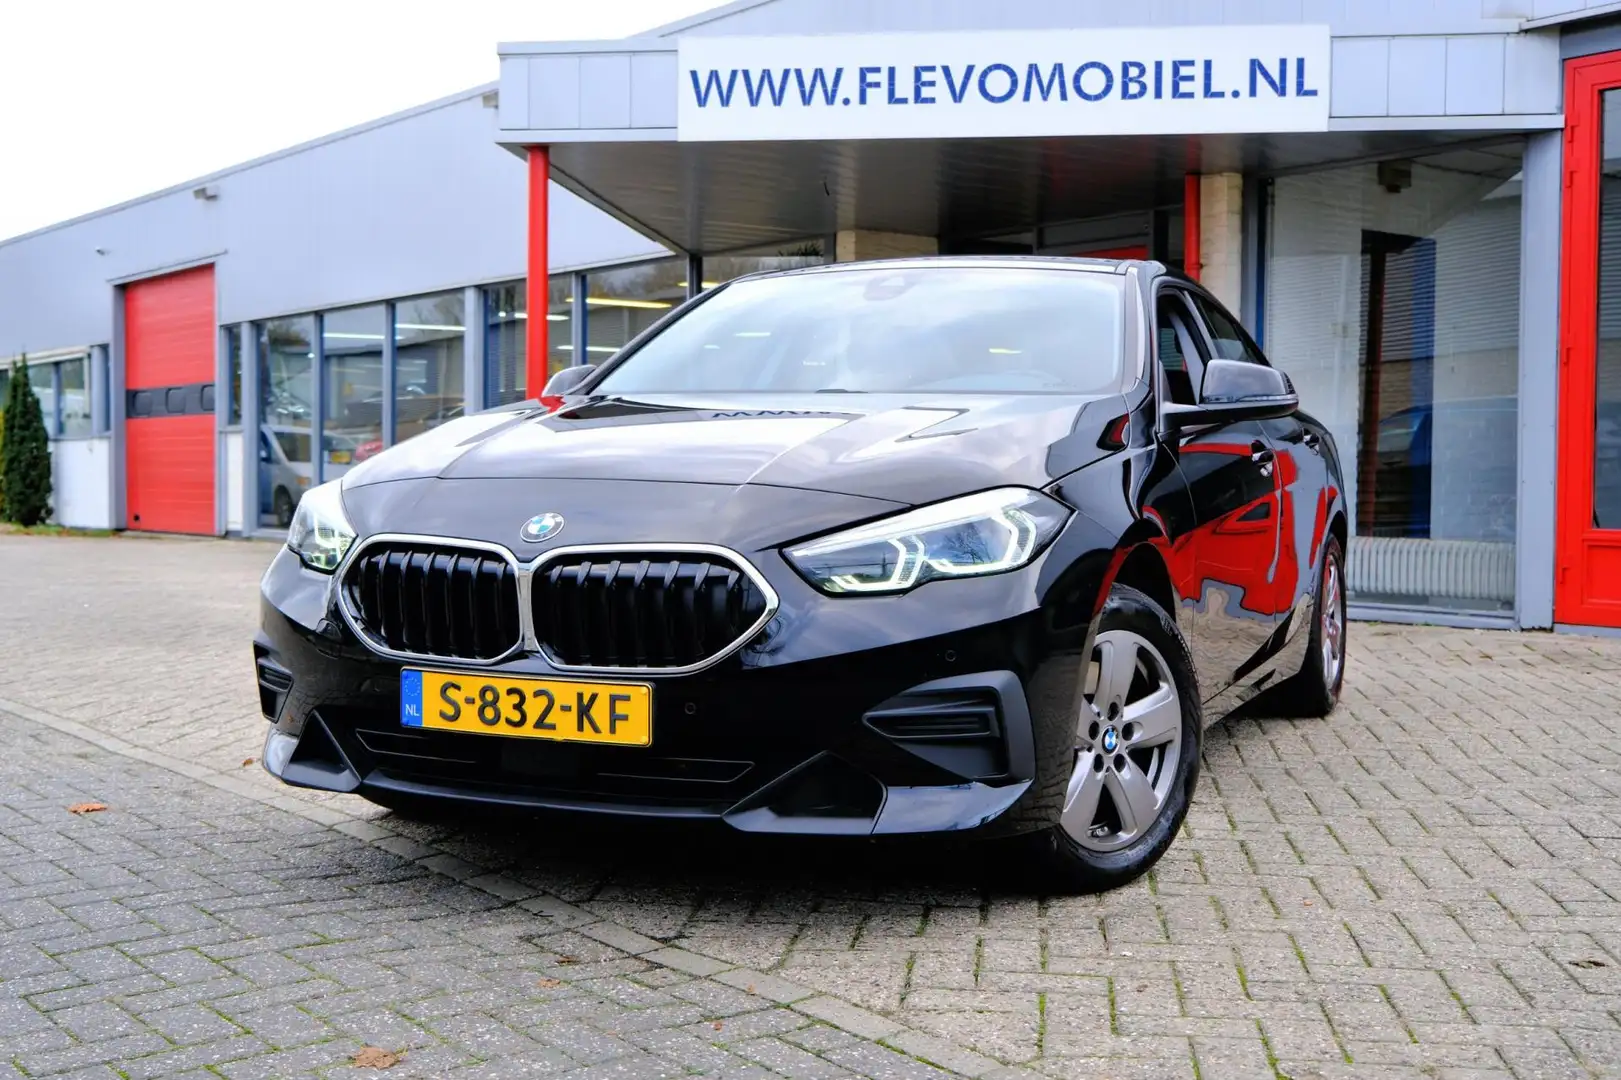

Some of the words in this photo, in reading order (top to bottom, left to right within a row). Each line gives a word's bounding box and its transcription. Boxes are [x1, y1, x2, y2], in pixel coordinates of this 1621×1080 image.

[689, 57, 1318, 108] WWW.FLEVOMOBIEL.NL
[405, 703, 419, 717] NL
[438, 681, 631, 735] S-832-KF
